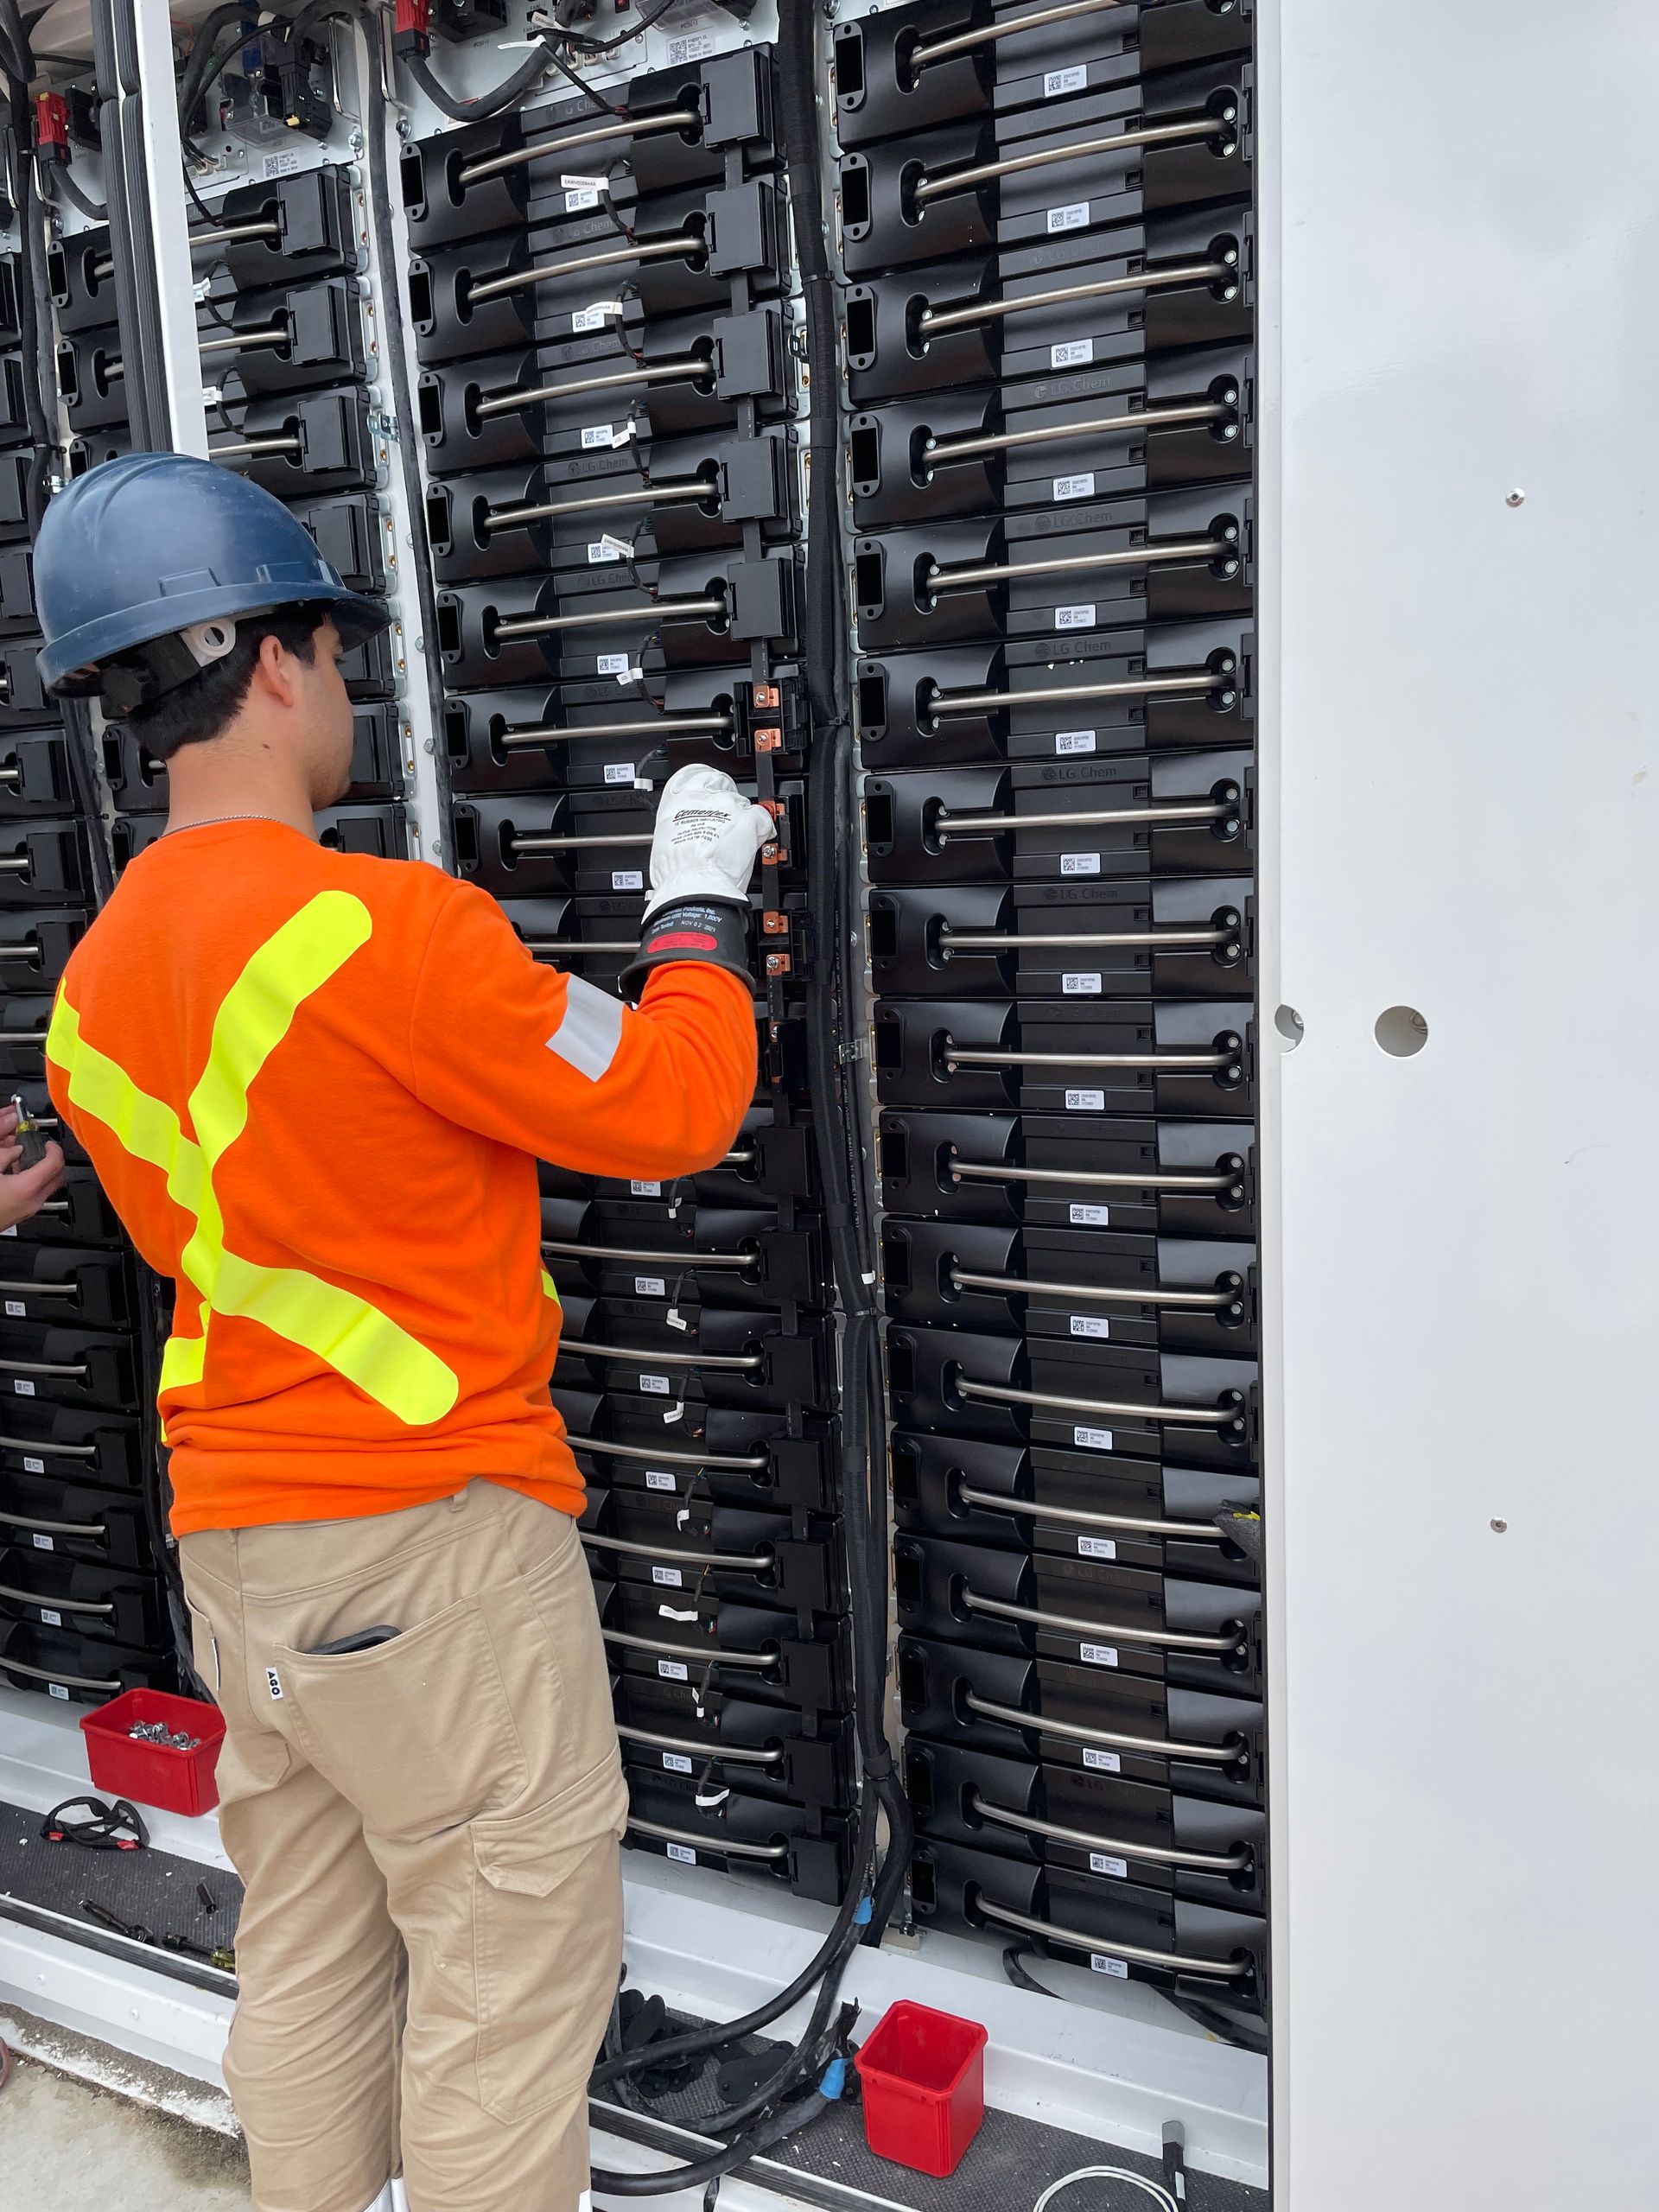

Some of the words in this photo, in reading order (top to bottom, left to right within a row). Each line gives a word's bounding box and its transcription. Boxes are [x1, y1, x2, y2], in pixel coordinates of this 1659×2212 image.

[1051, 381, 1068, 396] LG
[1071, 377, 1111, 392] Chem
[582, 460, 596, 474] LG
[599, 457, 629, 471] Chem
[1053, 515, 1072, 529] LG
[1076, 512, 1113, 525] Chem
[591, 574, 606, 588] LG
[1053, 642, 1070, 656] LG
[1074, 640, 1112, 654] Chem
[598, 685, 612, 697] LG
[1058, 767, 1077, 780] LG
[1080, 766, 1117, 779] Chem
[1061, 888, 1077, 900] LG
[1082, 887, 1118, 899] Chem
[704, 914, 723, 923] 1,000V
[268, 1671, 281, 1695] AGO
